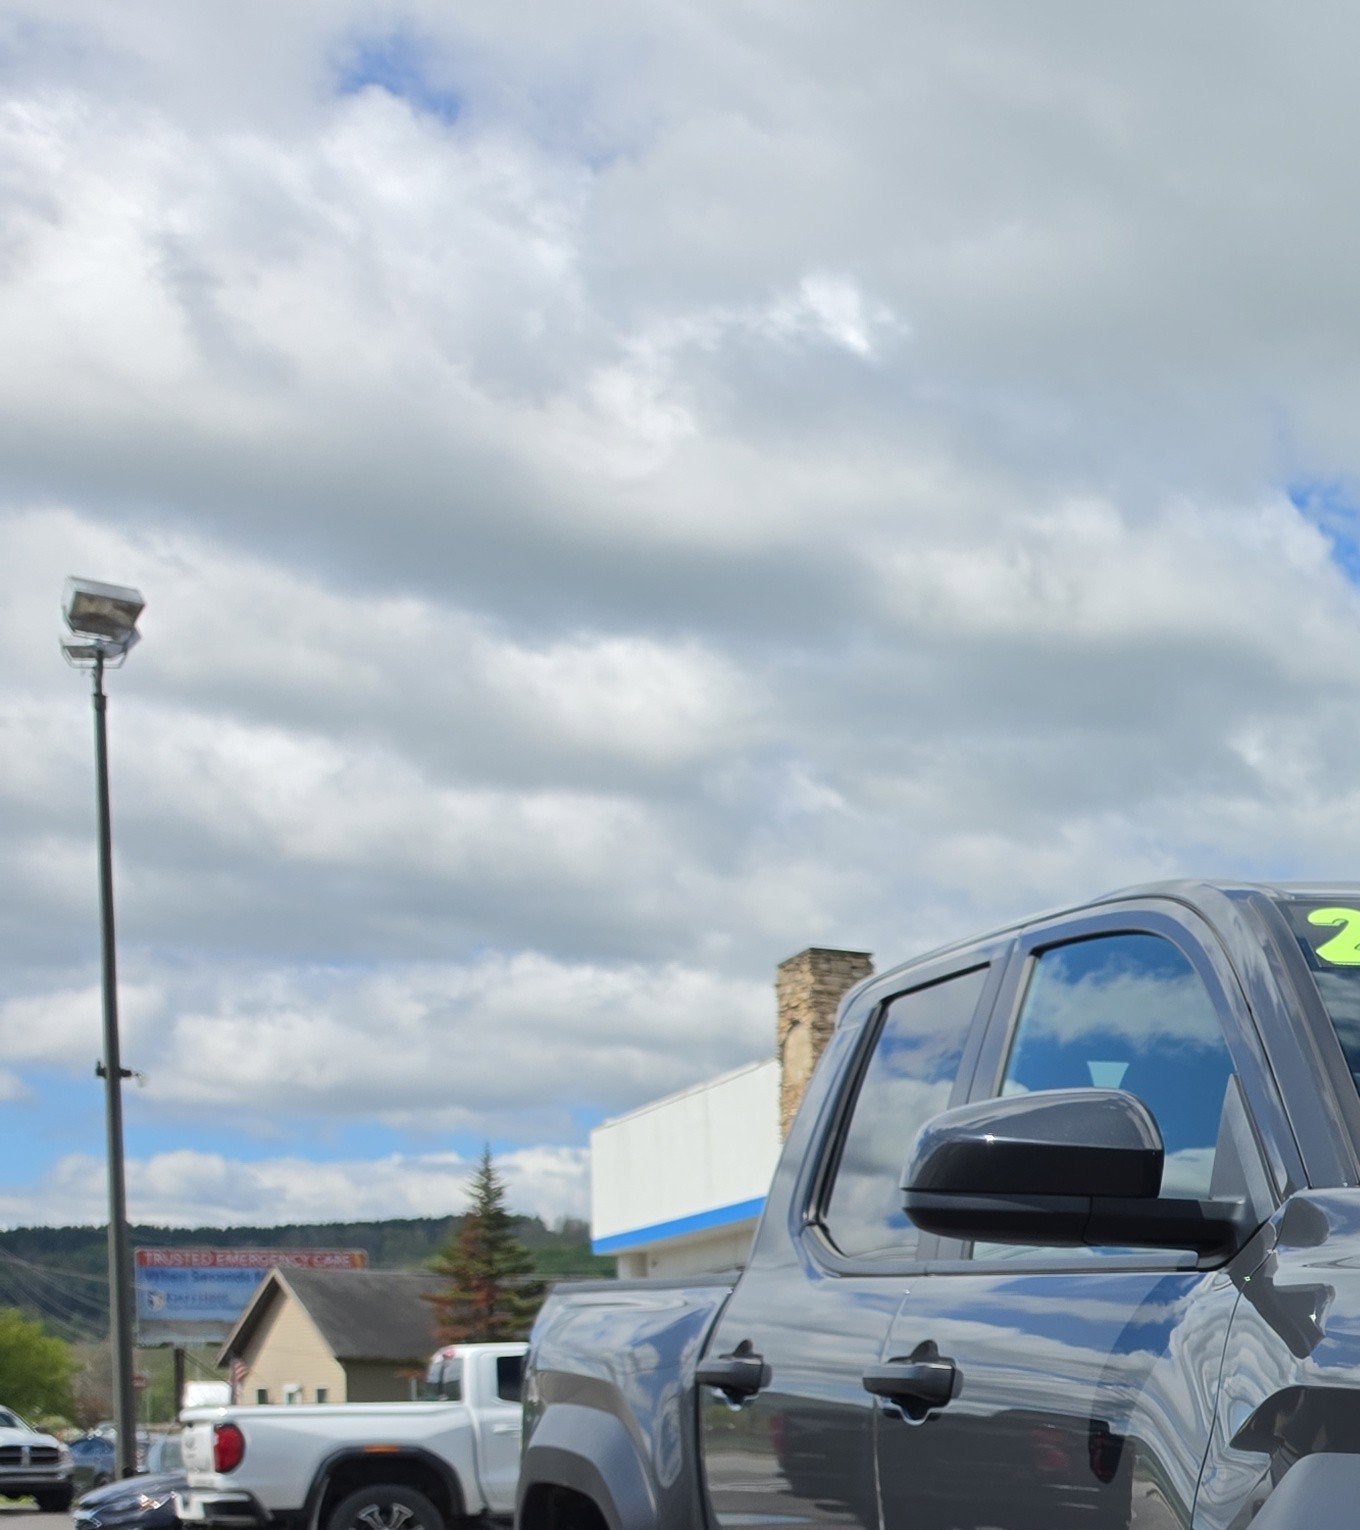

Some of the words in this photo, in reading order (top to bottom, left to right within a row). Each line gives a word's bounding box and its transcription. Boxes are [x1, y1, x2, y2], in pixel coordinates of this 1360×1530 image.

[145, 1251, 214, 1267] TRUSTED
[217, 1251, 309, 1268] EMERGENCY
[312, 1252, 350, 1267] CARE
